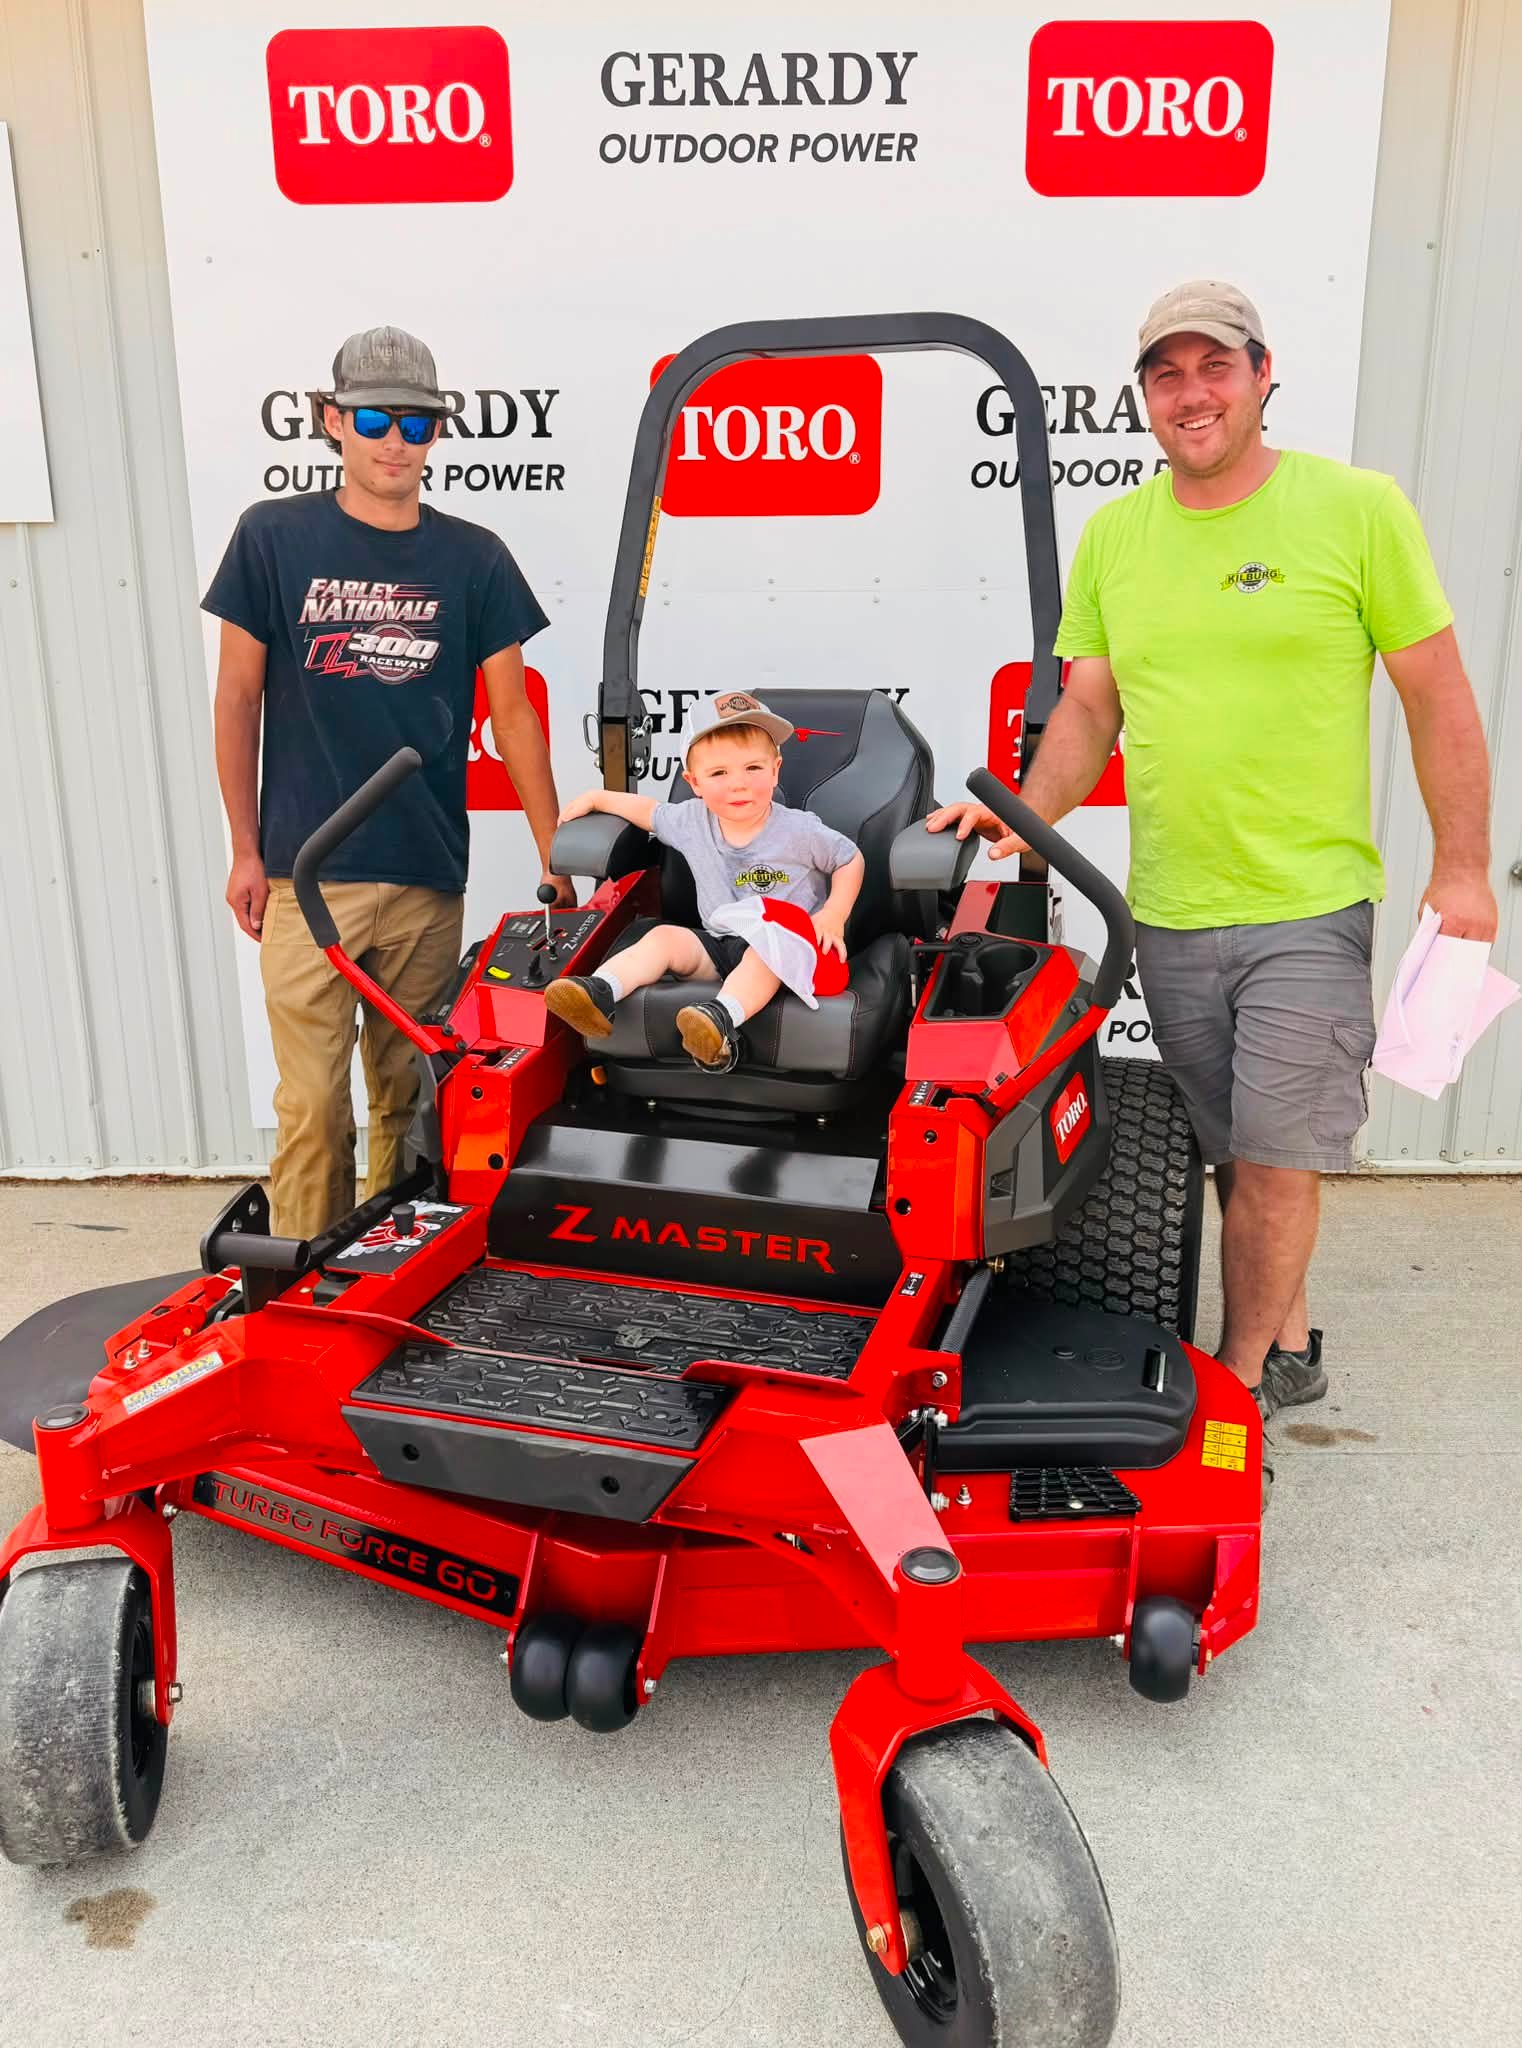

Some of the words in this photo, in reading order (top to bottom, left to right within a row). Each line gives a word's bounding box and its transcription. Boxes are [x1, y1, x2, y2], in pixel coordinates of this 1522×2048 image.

[600, 51, 919, 107] GERARDY
[599, 133, 779, 164] OUTDOOR
[788, 133, 919, 163] POWER
[444, 463, 566, 492] POWER
[307, 578, 399, 600] FARLEY
[1227, 568, 1278, 585] KILBURG
[298, 598, 440, 624] NATIONALS
[348, 632, 440, 660] 300
[360, 655, 428, 670] RACEWAY
[549, 1203, 598, 1243] Z
[611, 1216, 837, 1274] MASTER
[213, 1480, 314, 1533] TURBO
[320, 1519, 428, 1575] FORCE
[436, 1560, 497, 1601] 60
